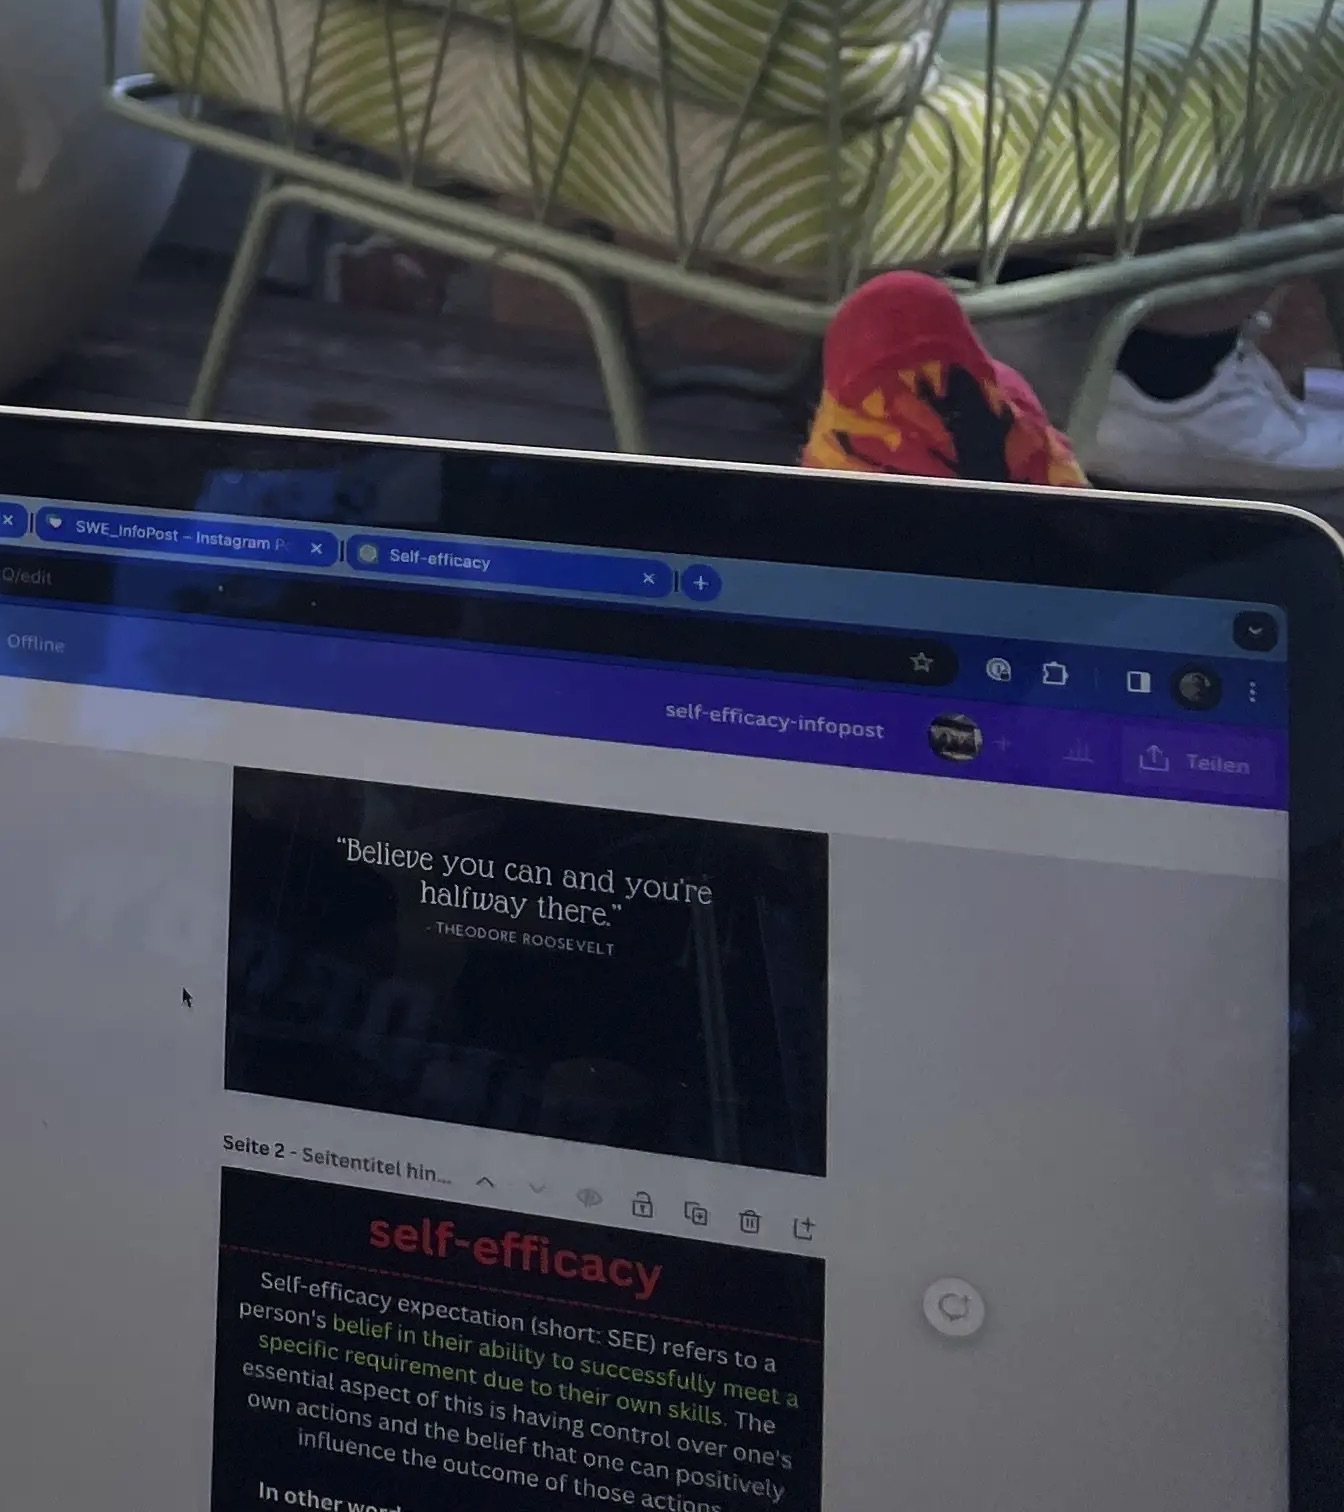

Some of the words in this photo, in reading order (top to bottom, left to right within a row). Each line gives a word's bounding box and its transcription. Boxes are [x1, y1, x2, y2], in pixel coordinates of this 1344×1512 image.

[75, 519, 179, 544] SWE_InfoPost
[196, 530, 271, 552] Instagram
[389, 548, 491, 573] Self-efficacy
[6, 633, 65, 655] Offline
[665, 699, 886, 741] self-efficacy-infopost
[1186, 752, 1251, 777] Teilen
[419, 879, 528, 919] halfway
[442, 853, 495, 879] you
[504, 860, 553, 886] can
[562, 868, 615, 894] and
[624, 876, 713, 906] you're
[436, 920, 517, 944] THEODORE
[522, 932, 615, 957] ROOSEVELT
[222, 1134, 270, 1156] Seite
[274, 1143, 285, 1159] 2
[302, 1147, 401, 1177] Seitentitel
[369, 1216, 663, 1300] self-efficacy
[261, 1271, 392, 1314] Self-efficacy
[397, 1295, 525, 1332] expectation
[531, 1315, 601, 1346] (short:
[608, 1328, 656, 1355] SEE)
[662, 1338, 728, 1366] refers
[735, 1349, 757, 1369] to
[764, 1358, 777, 1373] a
[239, 1300, 327, 1330] person's
[332, 1312, 393, 1340] belief
[397, 1322, 416, 1345] in
[423, 1328, 473, 1354] their
[478, 1338, 545, 1369] ability
[552, 1351, 574, 1372] to
[580, 1357, 717, 1398] successfully
[723, 1379, 780, 1405] meet
[786, 1392, 799, 1409] a
[258, 1333, 339, 1361] specific
[345, 1347, 478, 1385] requirement
[483, 1369, 524, 1392] due
[531, 1378, 553, 1397] to
[559, 1382, 610, 1408] their
[616, 1393, 662, 1417] own
[668, 1401, 727, 1428] skills.
[734, 1410, 777, 1435] The
[242, 1360, 334, 1390] essential
[340, 1377, 411, 1405] aspect
[416, 1390, 439, 1409] of
[444, 1393, 484, 1417] this
[489, 1400, 507, 1420] is
[512, 1403, 584, 1439] having
[590, 1421, 671, 1449] control
[677, 1435, 728, 1458] over
[733, 1445, 792, 1470] one's
[248, 1392, 291, 1414] own
[296, 1400, 373, 1428] actions
[378, 1415, 418, 1436] and
[424, 1421, 460, 1444] the
[465, 1426, 528, 1455] belief
[532, 1439, 577, 1465] that
[583, 1451, 625, 1472] one
[630, 1459, 670, 1481] can
[676, 1466, 786, 1505] positively
[297, 1426, 396, 1463] influence
[402, 1447, 437, 1470] the
[443, 1458, 539, 1488] outcome
[545, 1472, 568, 1493] of
[573, 1477, 635, 1505] those
[259, 1480, 279, 1502] In
[284, 1489, 344, 1512] other
